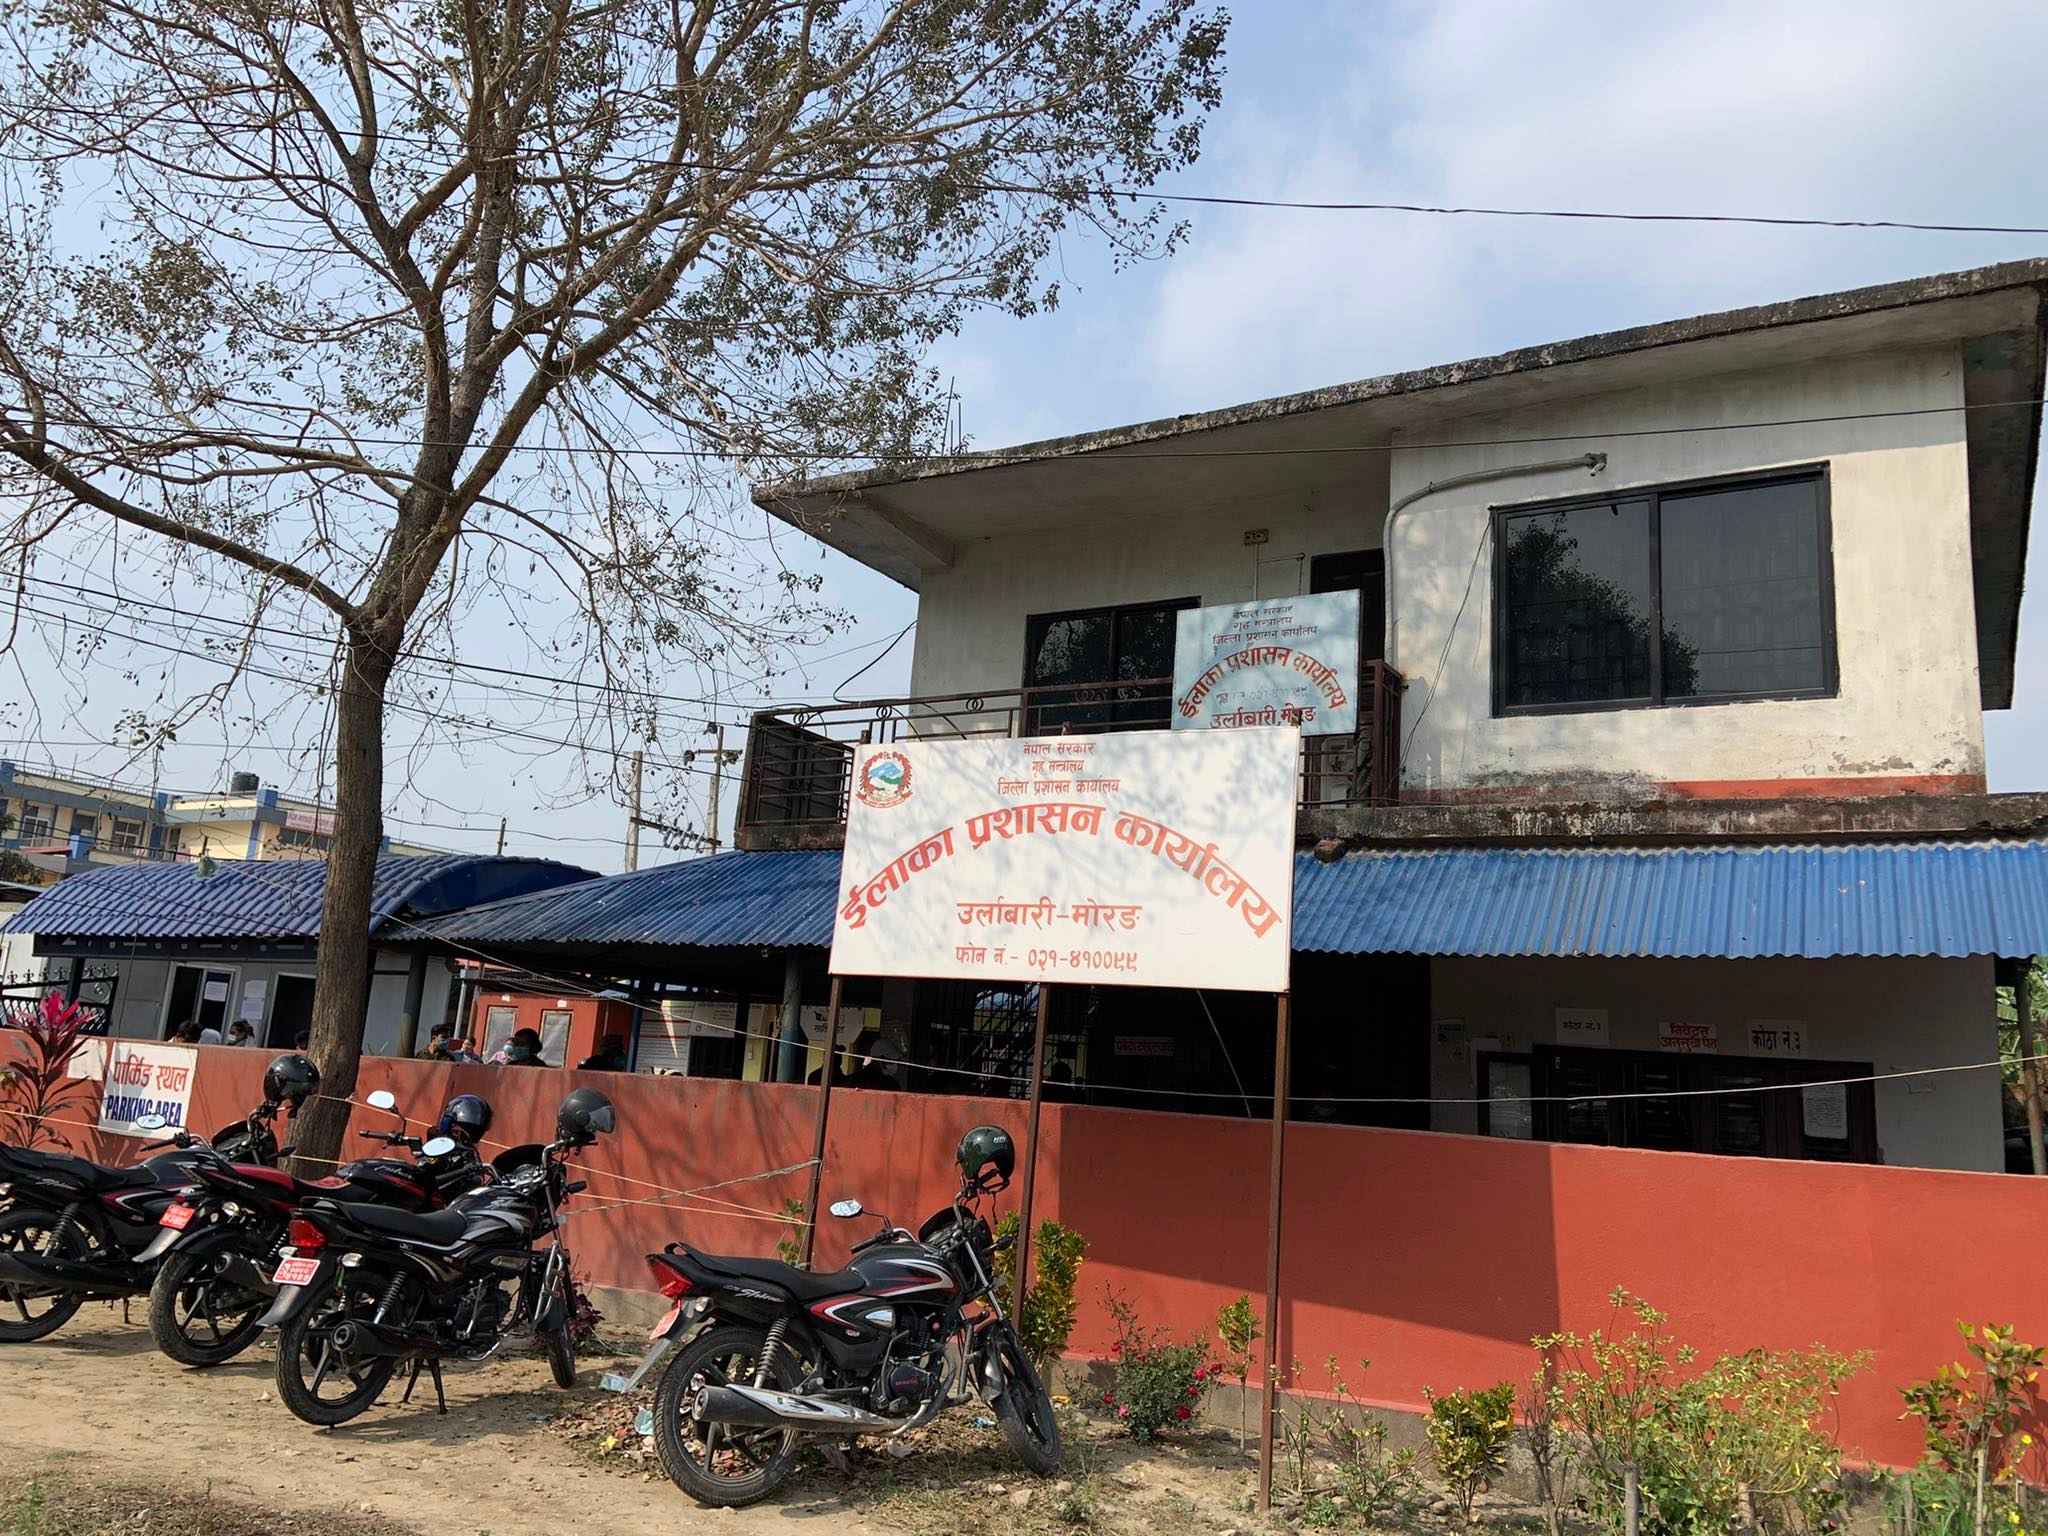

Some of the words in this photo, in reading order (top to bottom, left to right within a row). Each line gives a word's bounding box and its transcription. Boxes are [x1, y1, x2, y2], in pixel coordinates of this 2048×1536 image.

[1213, 633, 1241, 645] जिल्ला
[1246, 630, 1278, 642] प्रशासन
[1281, 625, 1319, 638] कार्यालय
[1224, 646, 1294, 673] प्रशासन
[1292, 651, 1348, 709] कार्यालय
[1023, 742, 1052, 755] नेपाल
[1057, 742, 1096, 756] सरकार
[1032, 760, 1045, 777] गृह
[1049, 760, 1085, 773] मन्त्रालय
[998, 776, 1029, 796] जिल्ला
[1034, 779, 1072, 796] प्रशासन
[1076, 775, 1121, 794] कार्यालय
[965, 802, 1107, 850] प्रशासन
[1114, 810, 1282, 939] कार्यालय
[956, 941, 987, 964] फोन
[1752, 1024, 1777, 1050] कोठा
[156, 1065, 190, 1093] स्थल
[105, 1095, 153, 1123] PARKING
[155, 1100, 182, 1128] AREA
